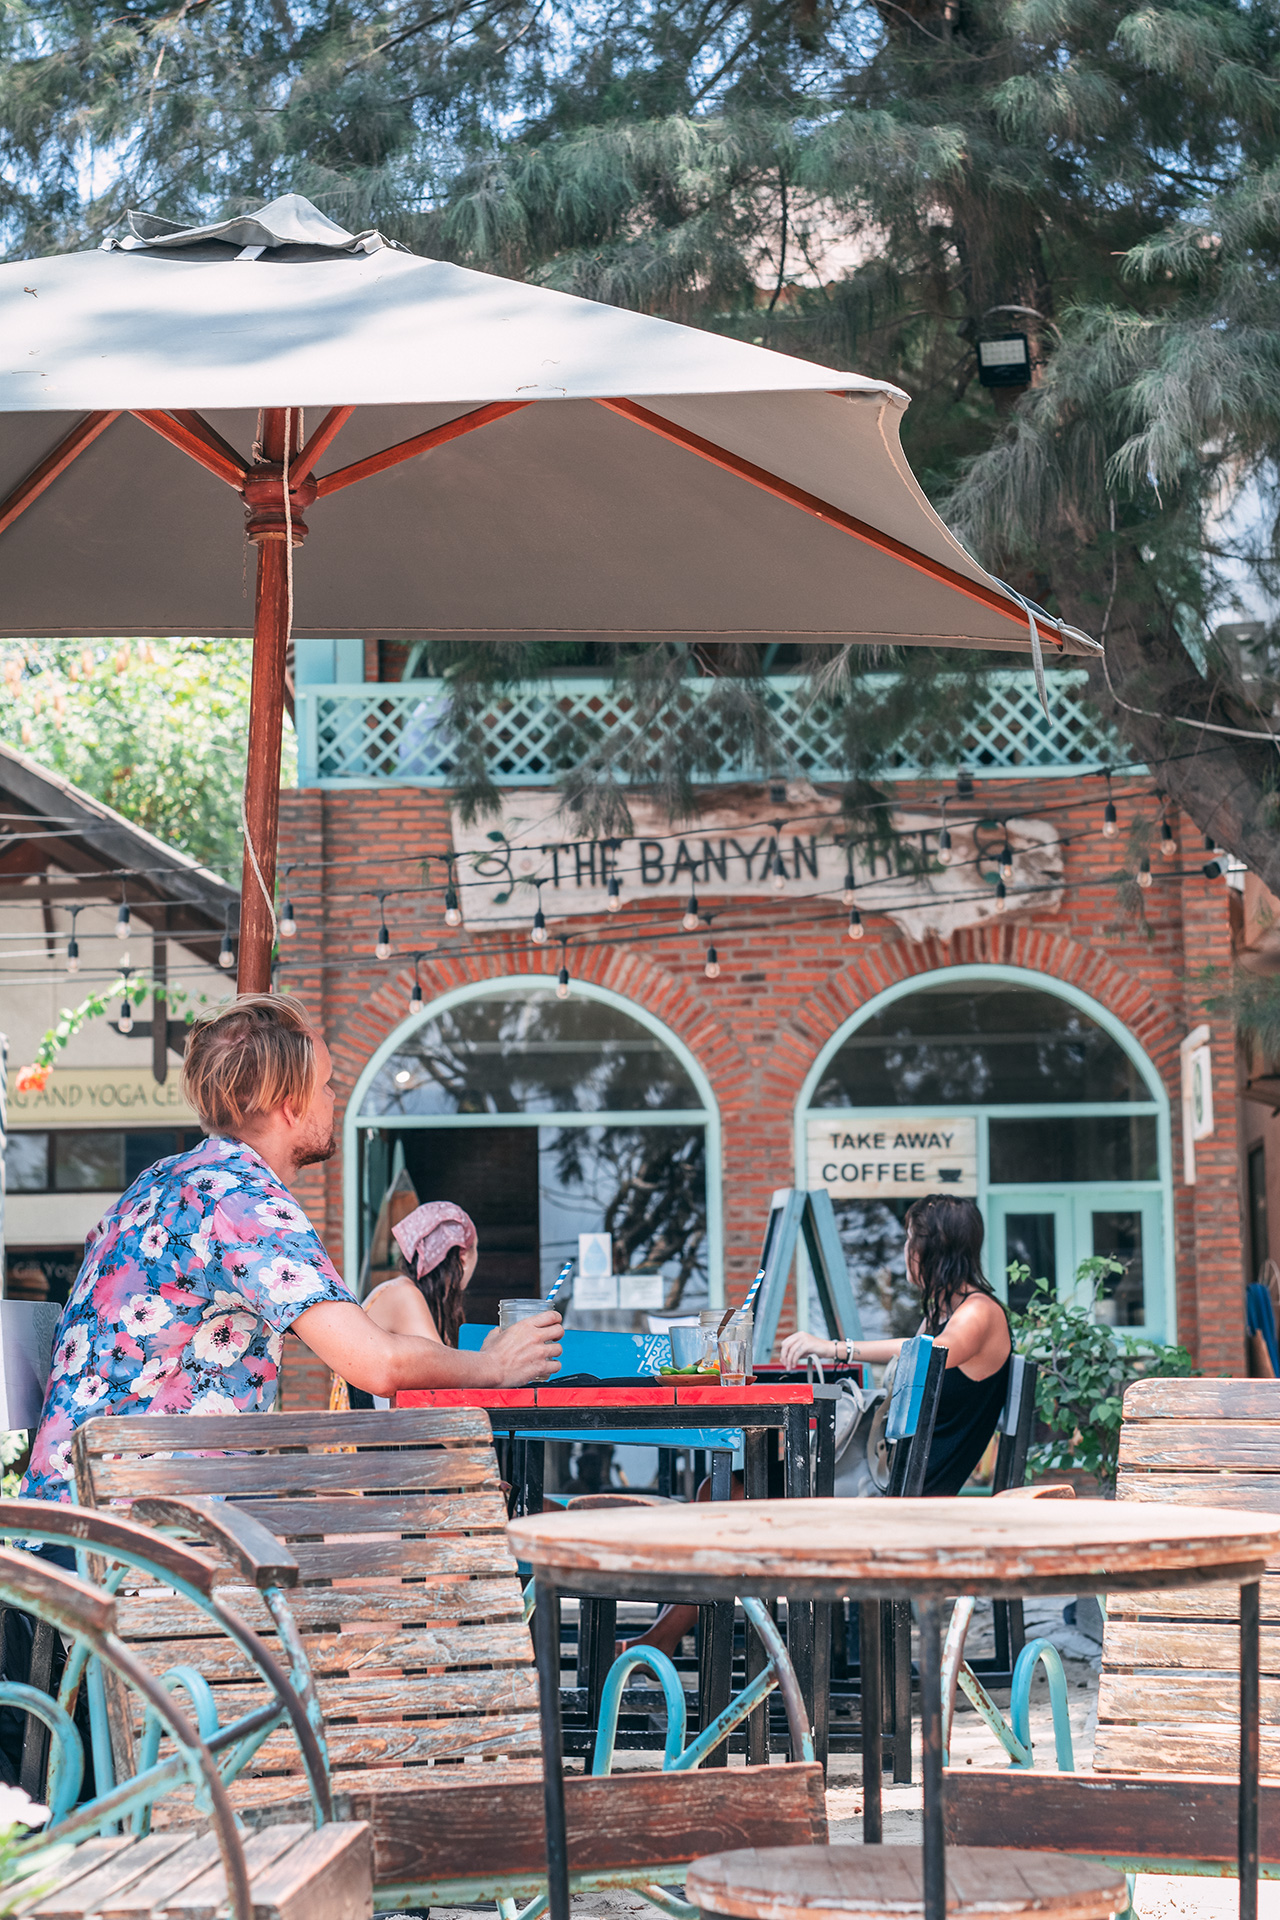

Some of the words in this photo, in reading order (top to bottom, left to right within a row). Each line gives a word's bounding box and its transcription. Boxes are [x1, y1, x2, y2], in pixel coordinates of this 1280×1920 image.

[541, 841, 624, 888] THE
[639, 835, 819, 885] BANYAN
[33, 1084, 84, 1107] AND
[87, 1083, 148, 1107] YOGA
[152, 1082, 184, 1107] CE
[830, 1133, 886, 1149] TAKE
[893, 1132, 955, 1149] AWAY
[822, 1163, 926, 1182] COFFEE
[43, 1261, 79, 1283] Yog
